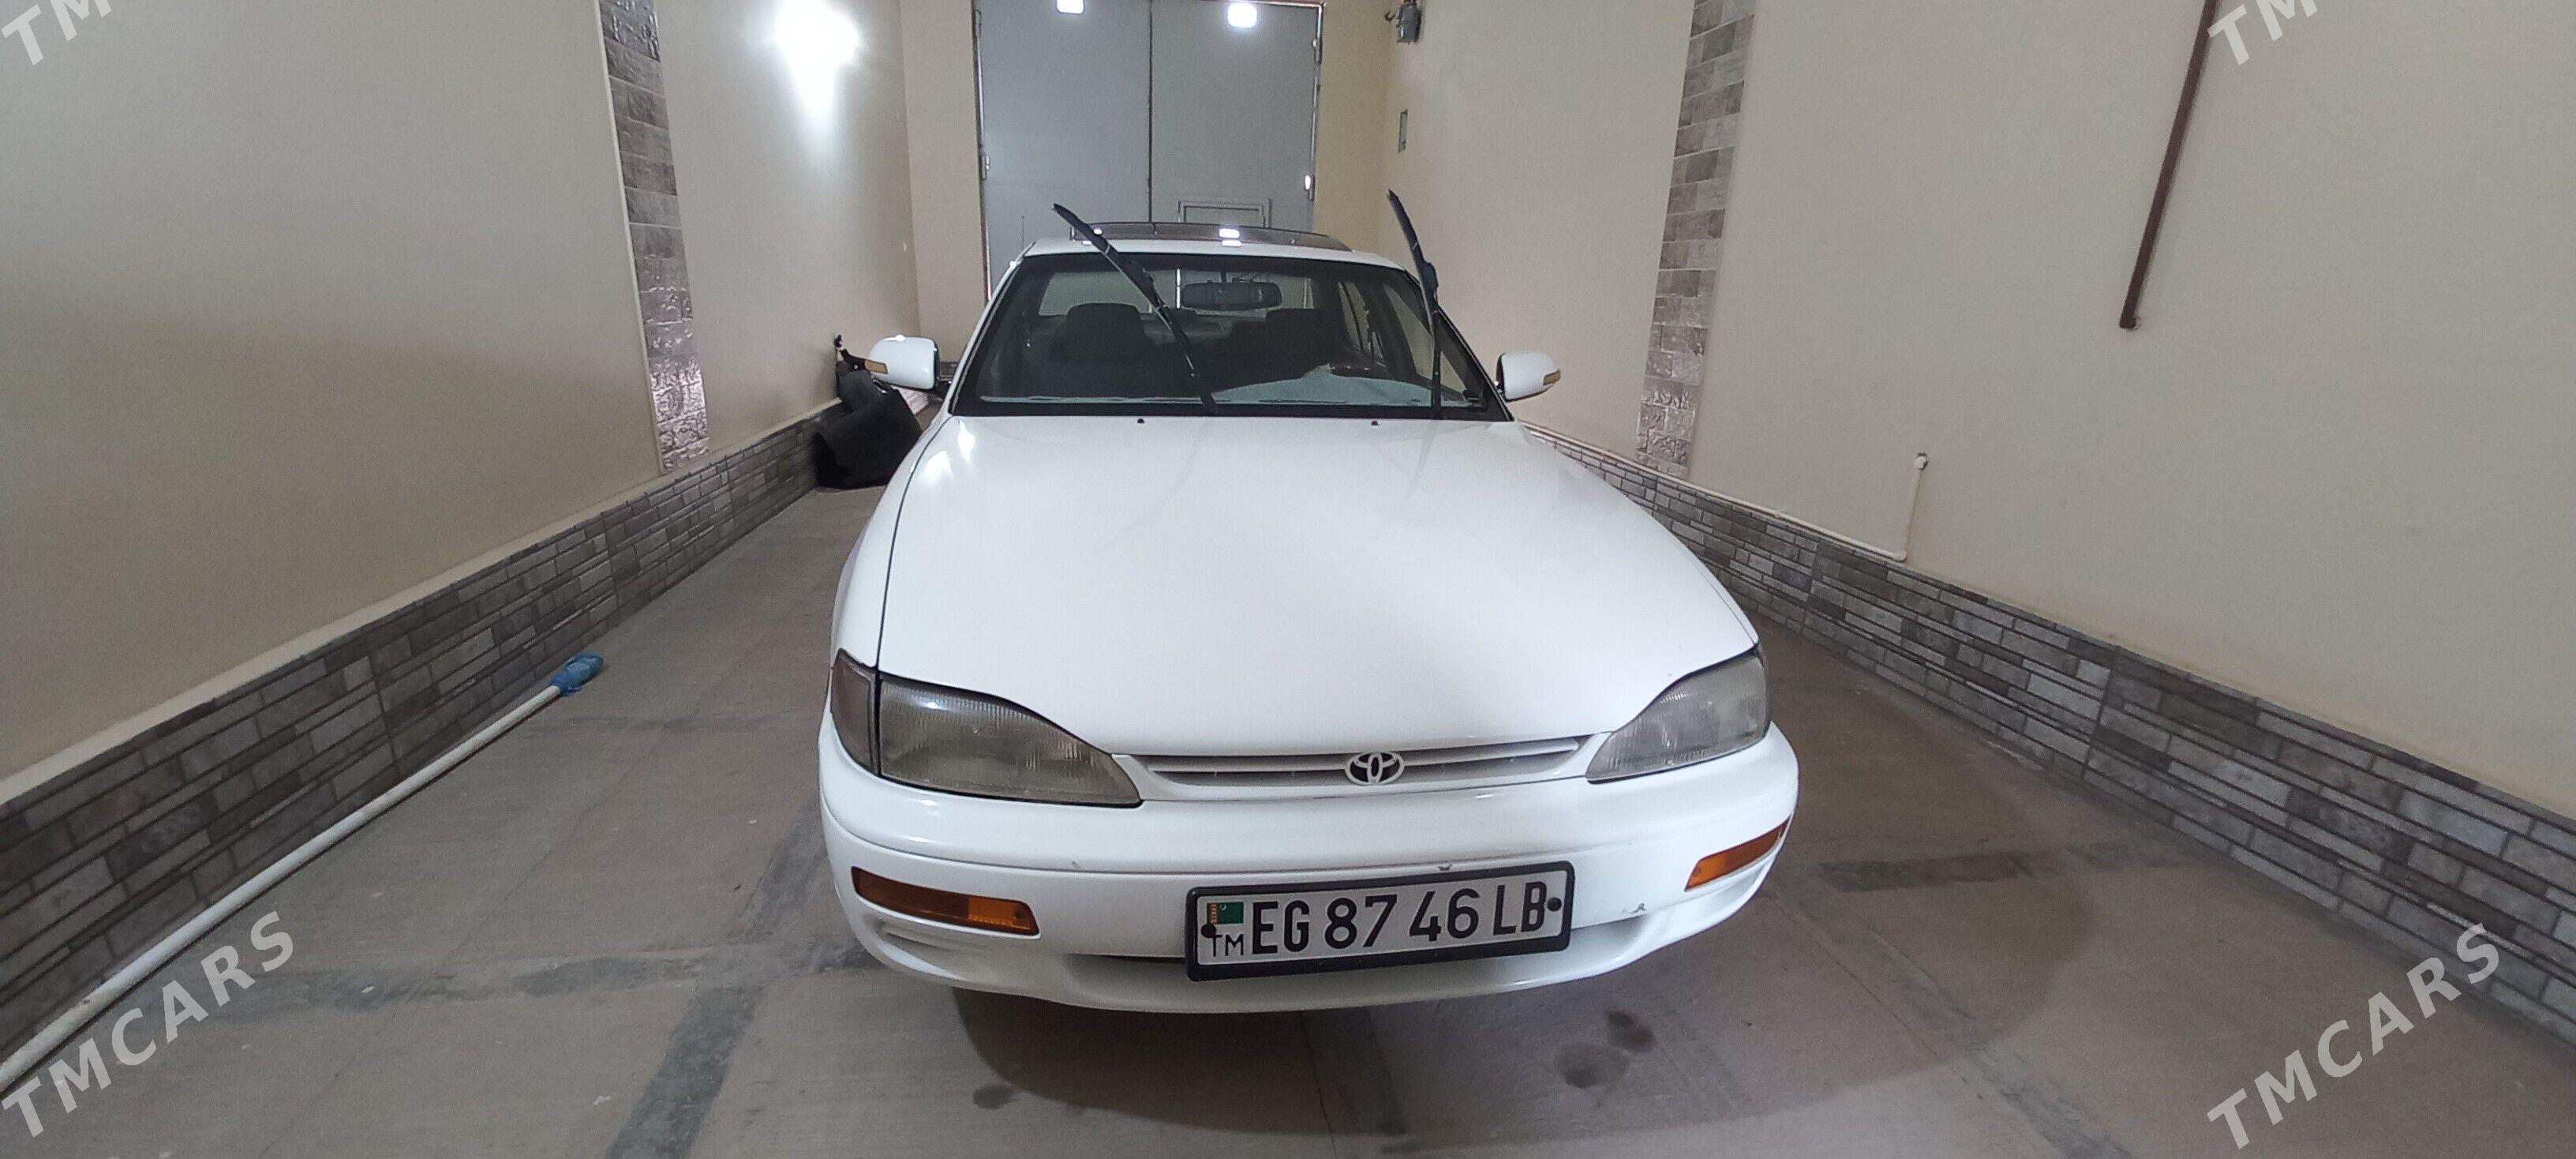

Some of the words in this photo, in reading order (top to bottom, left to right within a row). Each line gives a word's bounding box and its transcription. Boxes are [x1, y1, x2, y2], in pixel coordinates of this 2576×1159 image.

[1252, 898, 1310, 955] EG
[1324, 894, 1398, 949] 87
[1409, 888, 1481, 942] 46
[1493, 880, 1548, 936] LB
[1212, 933, 1244, 956] TM
